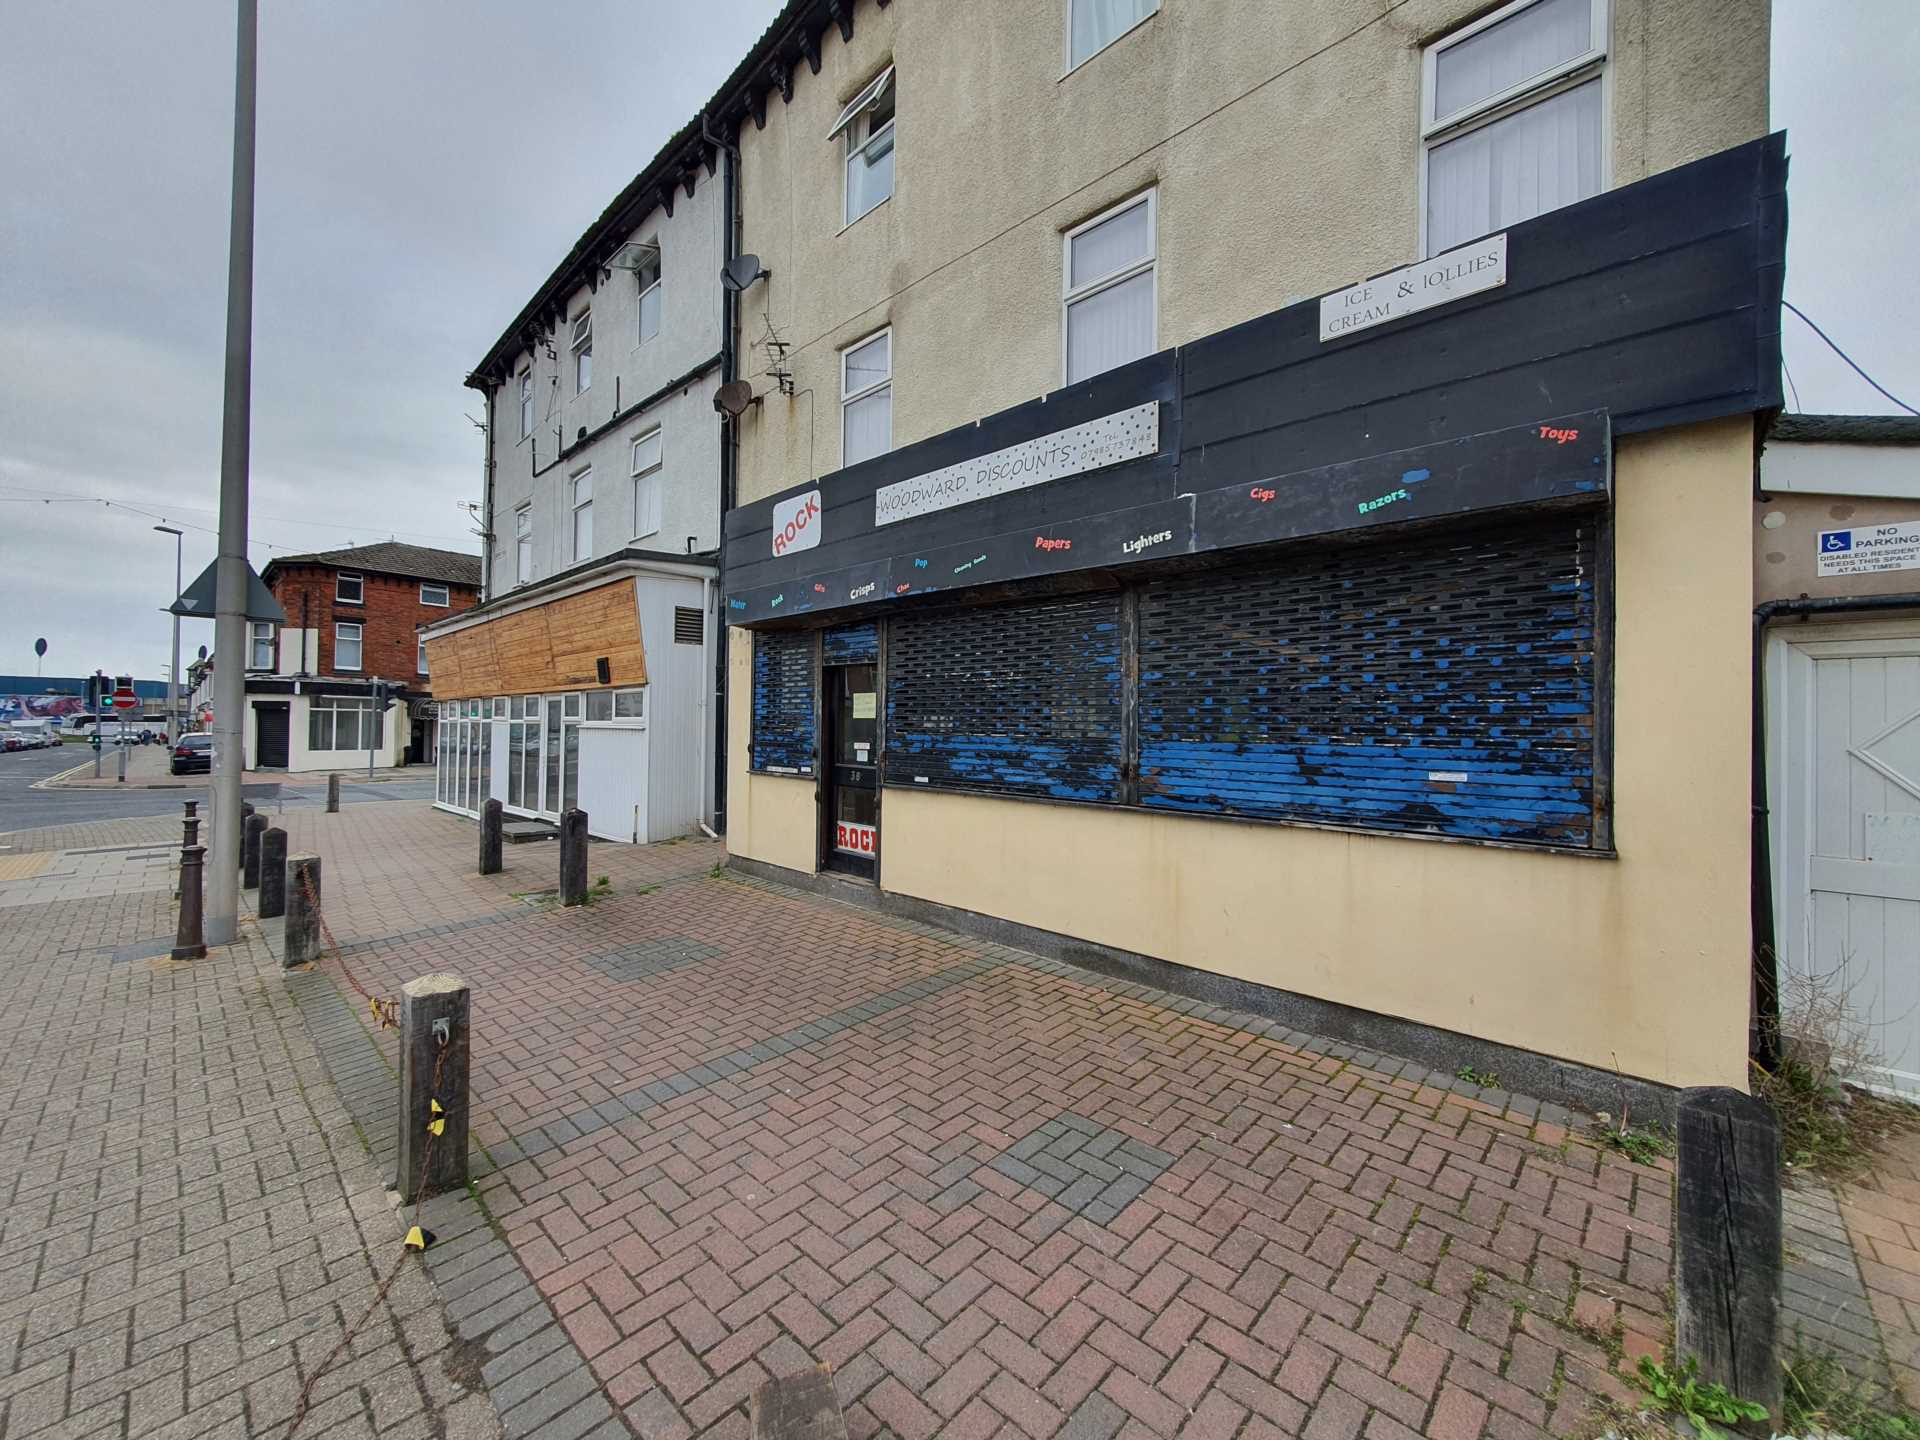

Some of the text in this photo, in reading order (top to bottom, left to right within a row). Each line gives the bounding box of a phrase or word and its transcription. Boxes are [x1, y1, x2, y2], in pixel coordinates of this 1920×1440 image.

[1344, 287, 1374, 308] ICE
[1397, 280, 1415, 298] &
[1328, 302, 1391, 333] CREAM
[1540, 426, 1579, 444] Toys
[880, 445, 1072, 513] WOODWARD DISCOUNTS
[1250, 487, 1276, 502] Cigs
[1358, 489, 1407, 514] Razors
[774, 494, 820, 555] ROCK
[1876, 527, 1898, 536] NO
[1034, 536, 1072, 551] Papers
[1122, 530, 1173, 554] Lighters
[1855, 535, 1920, 548] PARKING
[914, 558, 928, 568] Pop
[1820, 551, 1868, 562] DISABLED
[1823, 560, 1857, 568] NEEDS
[1883, 554, 1917, 562] SPACE
[1851, 564, 1868, 572] ALL
[1872, 562, 1902, 570] TIMES
[850, 581, 876, 600] Crisps
